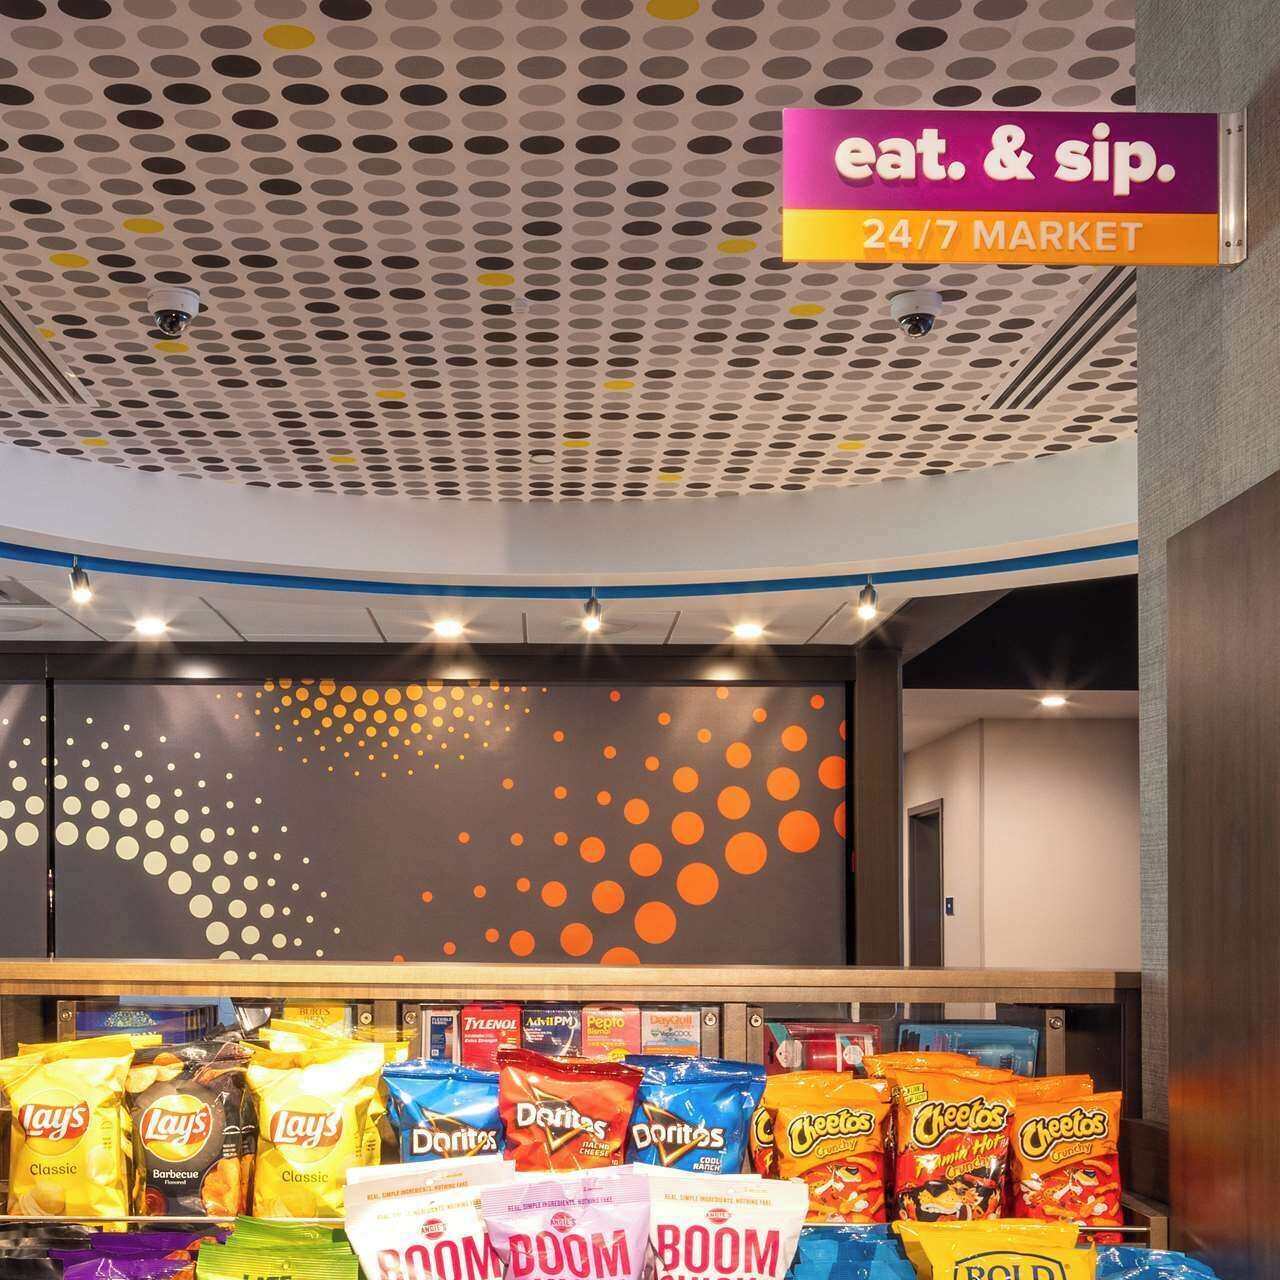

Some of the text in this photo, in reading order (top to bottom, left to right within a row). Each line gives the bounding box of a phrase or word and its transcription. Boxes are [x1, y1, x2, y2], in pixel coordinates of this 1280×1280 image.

[835, 122, 1176, 196] eat. & sip.
[863, 218, 1144, 253] 24/7 MARKET
[464, 1016, 518, 1031] TYLENOL
[526, 1016, 573, 1026] Advil PM
[586, 1015, 625, 1028] Pepto
[23, 1102, 87, 1141] Lay's
[145, 1109, 210, 1146] Lay's
[274, 1103, 343, 1147] Lay's
[516, 1102, 608, 1140] Doritos
[632, 1122, 725, 1150] Doritos
[789, 1111, 876, 1157] Cheetos
[911, 1096, 1008, 1148] Cheetos
[1018, 1107, 1109, 1160] Cheetos
[412, 1127, 497, 1154] Doritos
[579, 1148, 611, 1158] CHEESE
[29, 1162, 78, 1177] Classic
[153, 1168, 199, 1179] Barbecue
[281, 1170, 329, 1184] Classic
[508, 1229, 632, 1279] BOOM
[657, 1224, 780, 1278] BOOM
